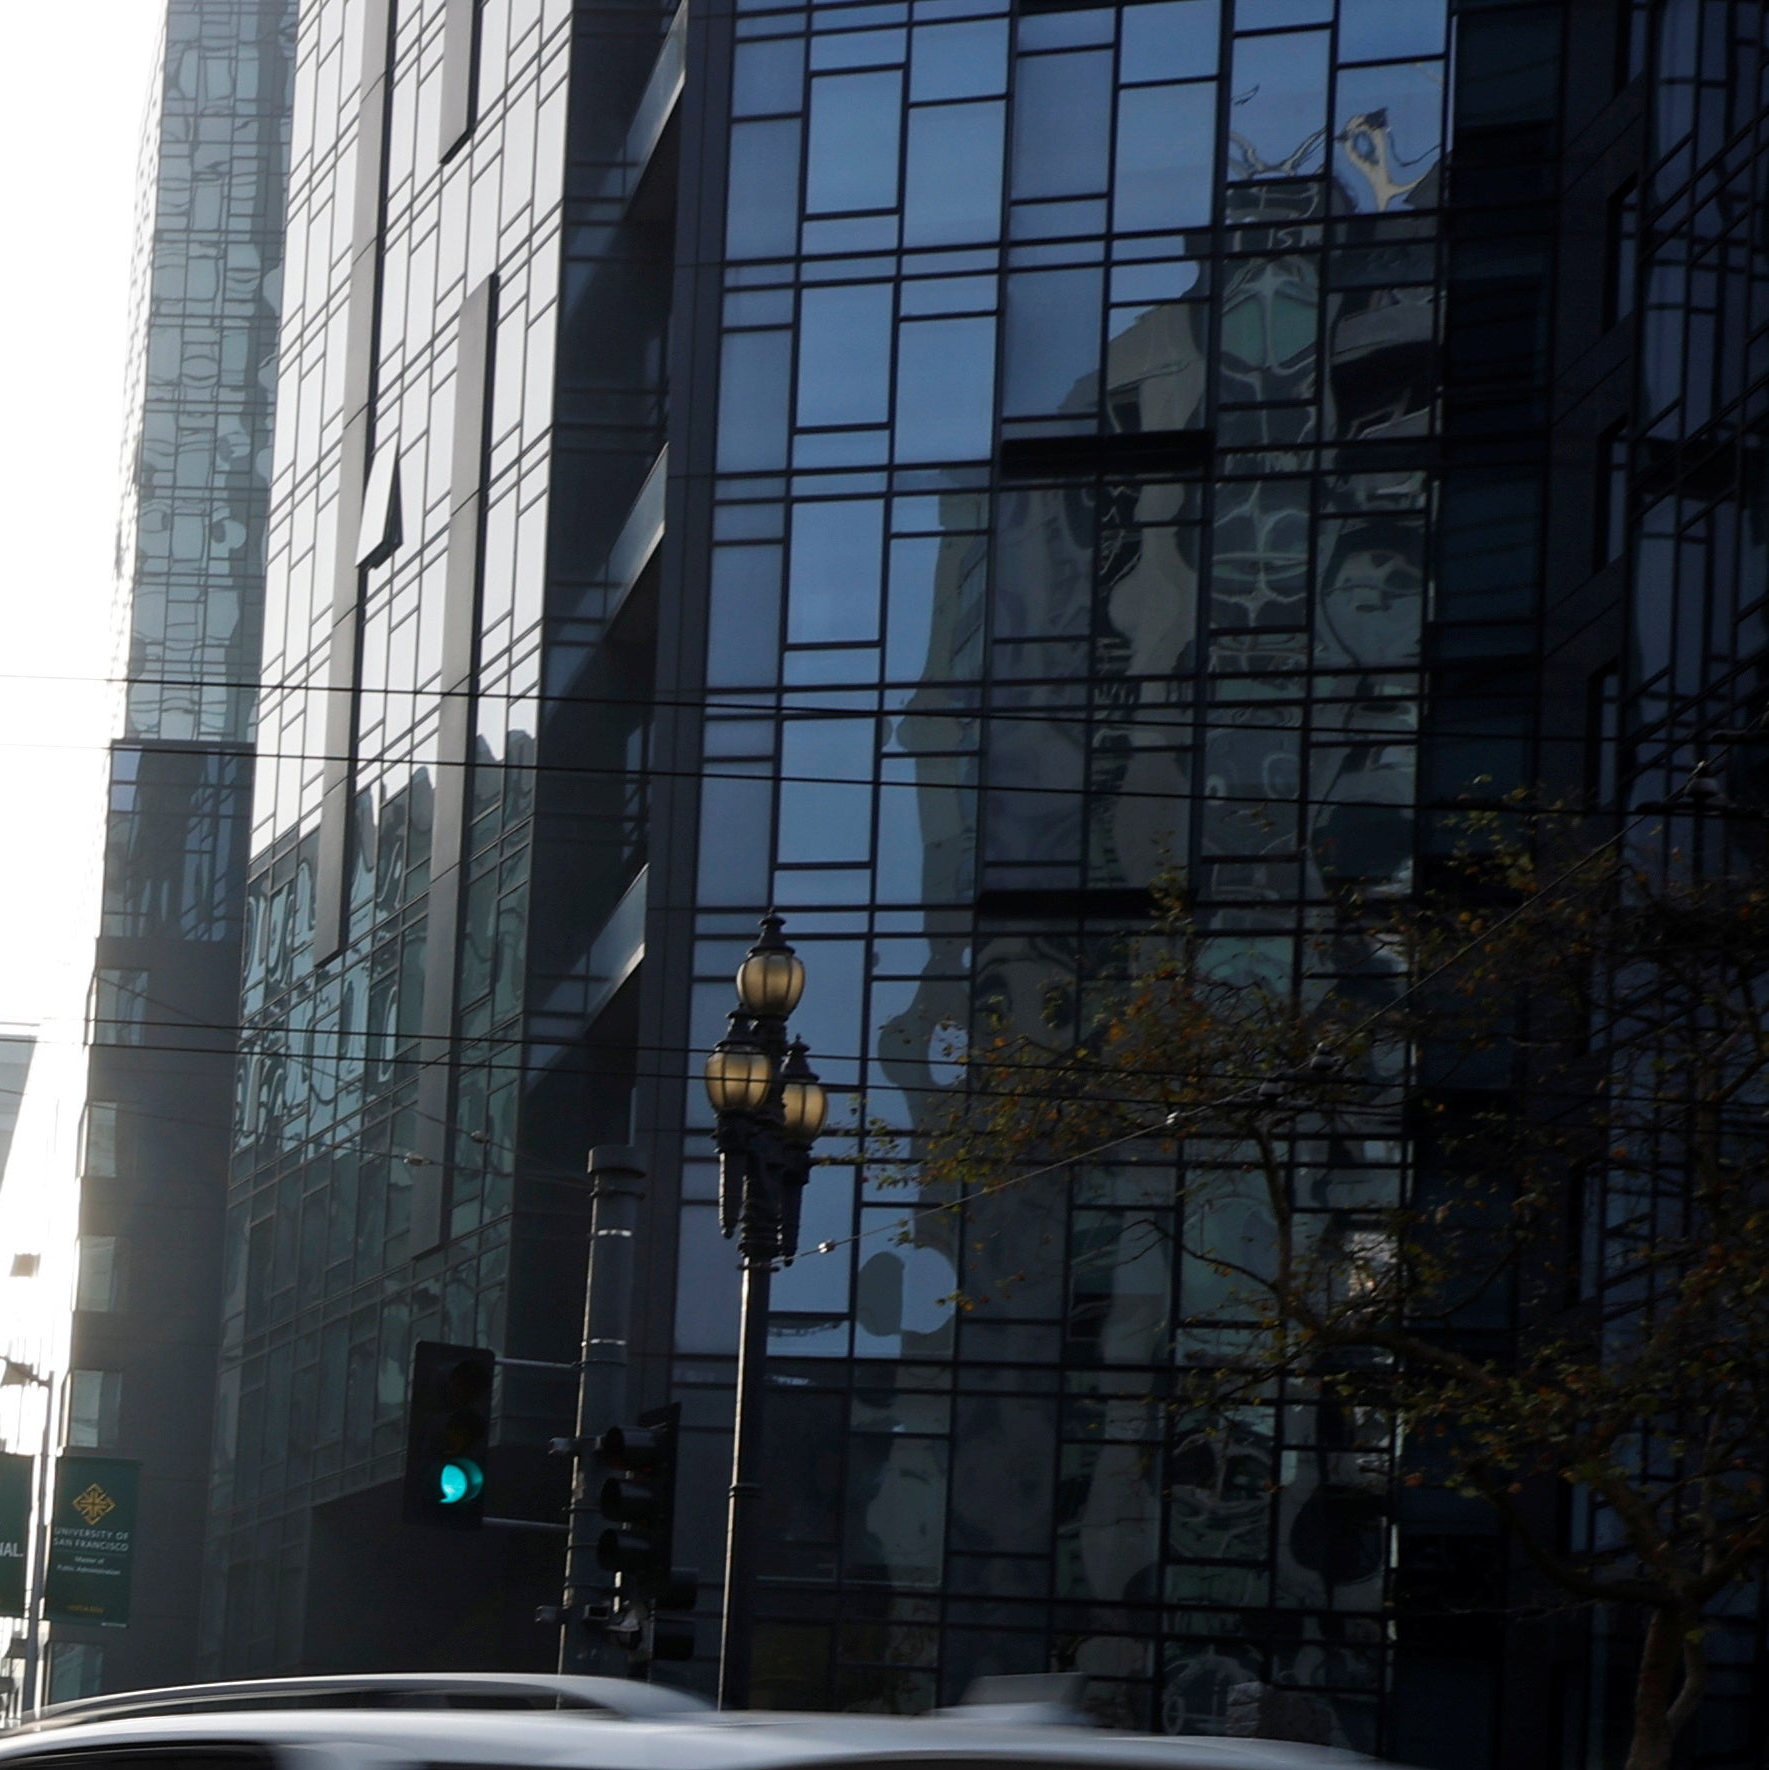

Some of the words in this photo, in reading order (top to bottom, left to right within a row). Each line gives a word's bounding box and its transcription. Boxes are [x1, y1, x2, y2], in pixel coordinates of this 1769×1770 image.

[53, 1526, 113, 1539] UNIVERSITY
[115, 1531, 130, 1541] OF
[52, 1537, 73, 1547] SAN
[75, 1539, 130, 1552] FRANCISCO
